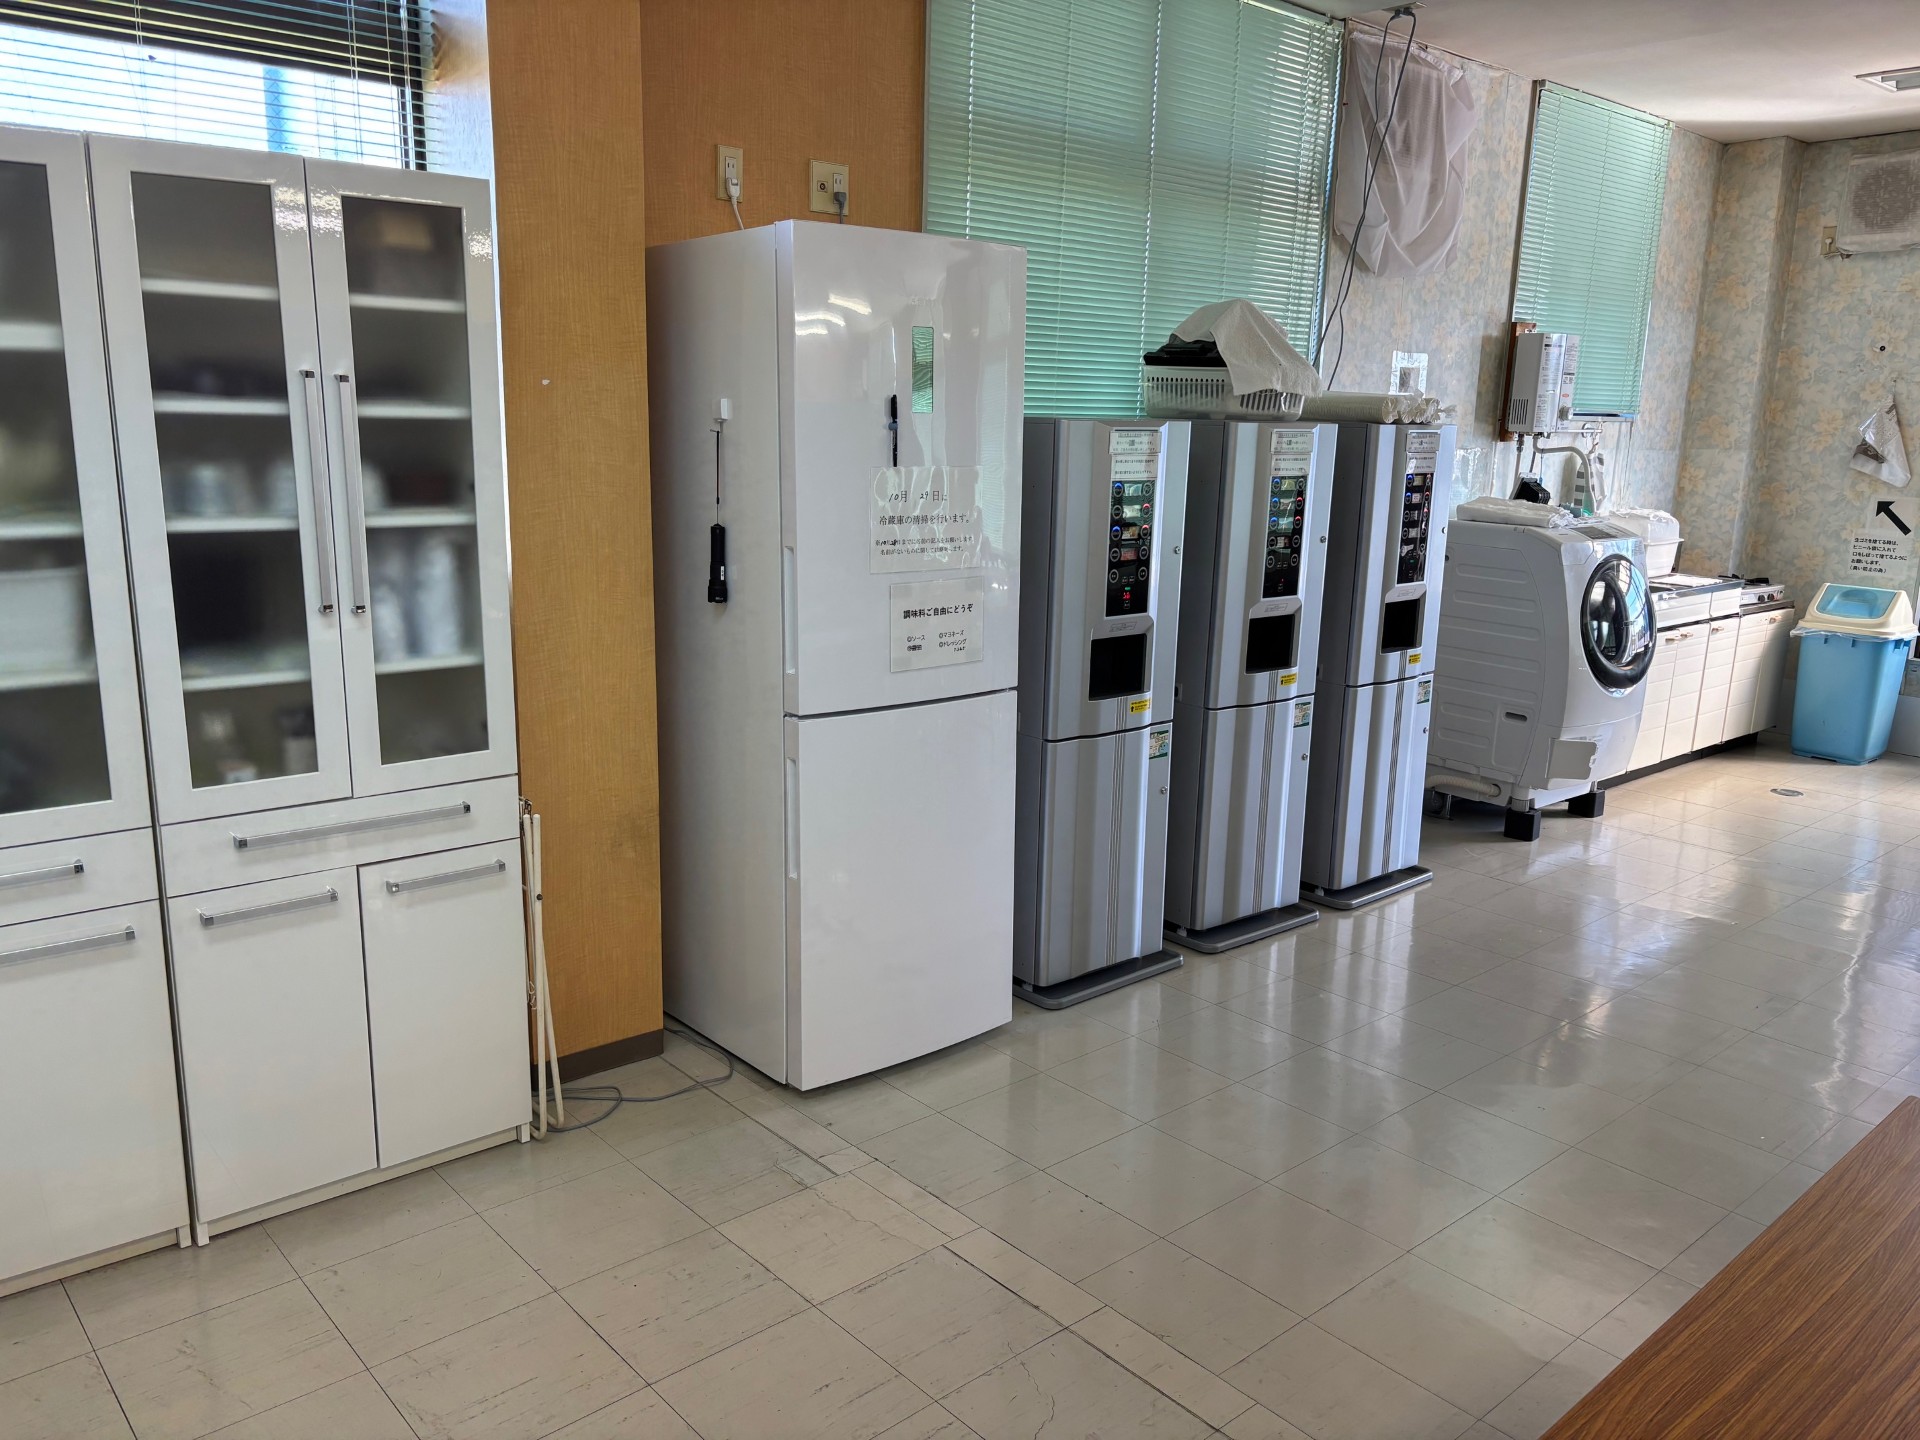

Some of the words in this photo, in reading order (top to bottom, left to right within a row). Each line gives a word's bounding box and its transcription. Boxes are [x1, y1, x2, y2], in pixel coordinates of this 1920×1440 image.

[879, 513, 970, 526] 冷蔵庫の清掃を行います。
[903, 603, 974, 619] 調味料ご自由にどうぞ
